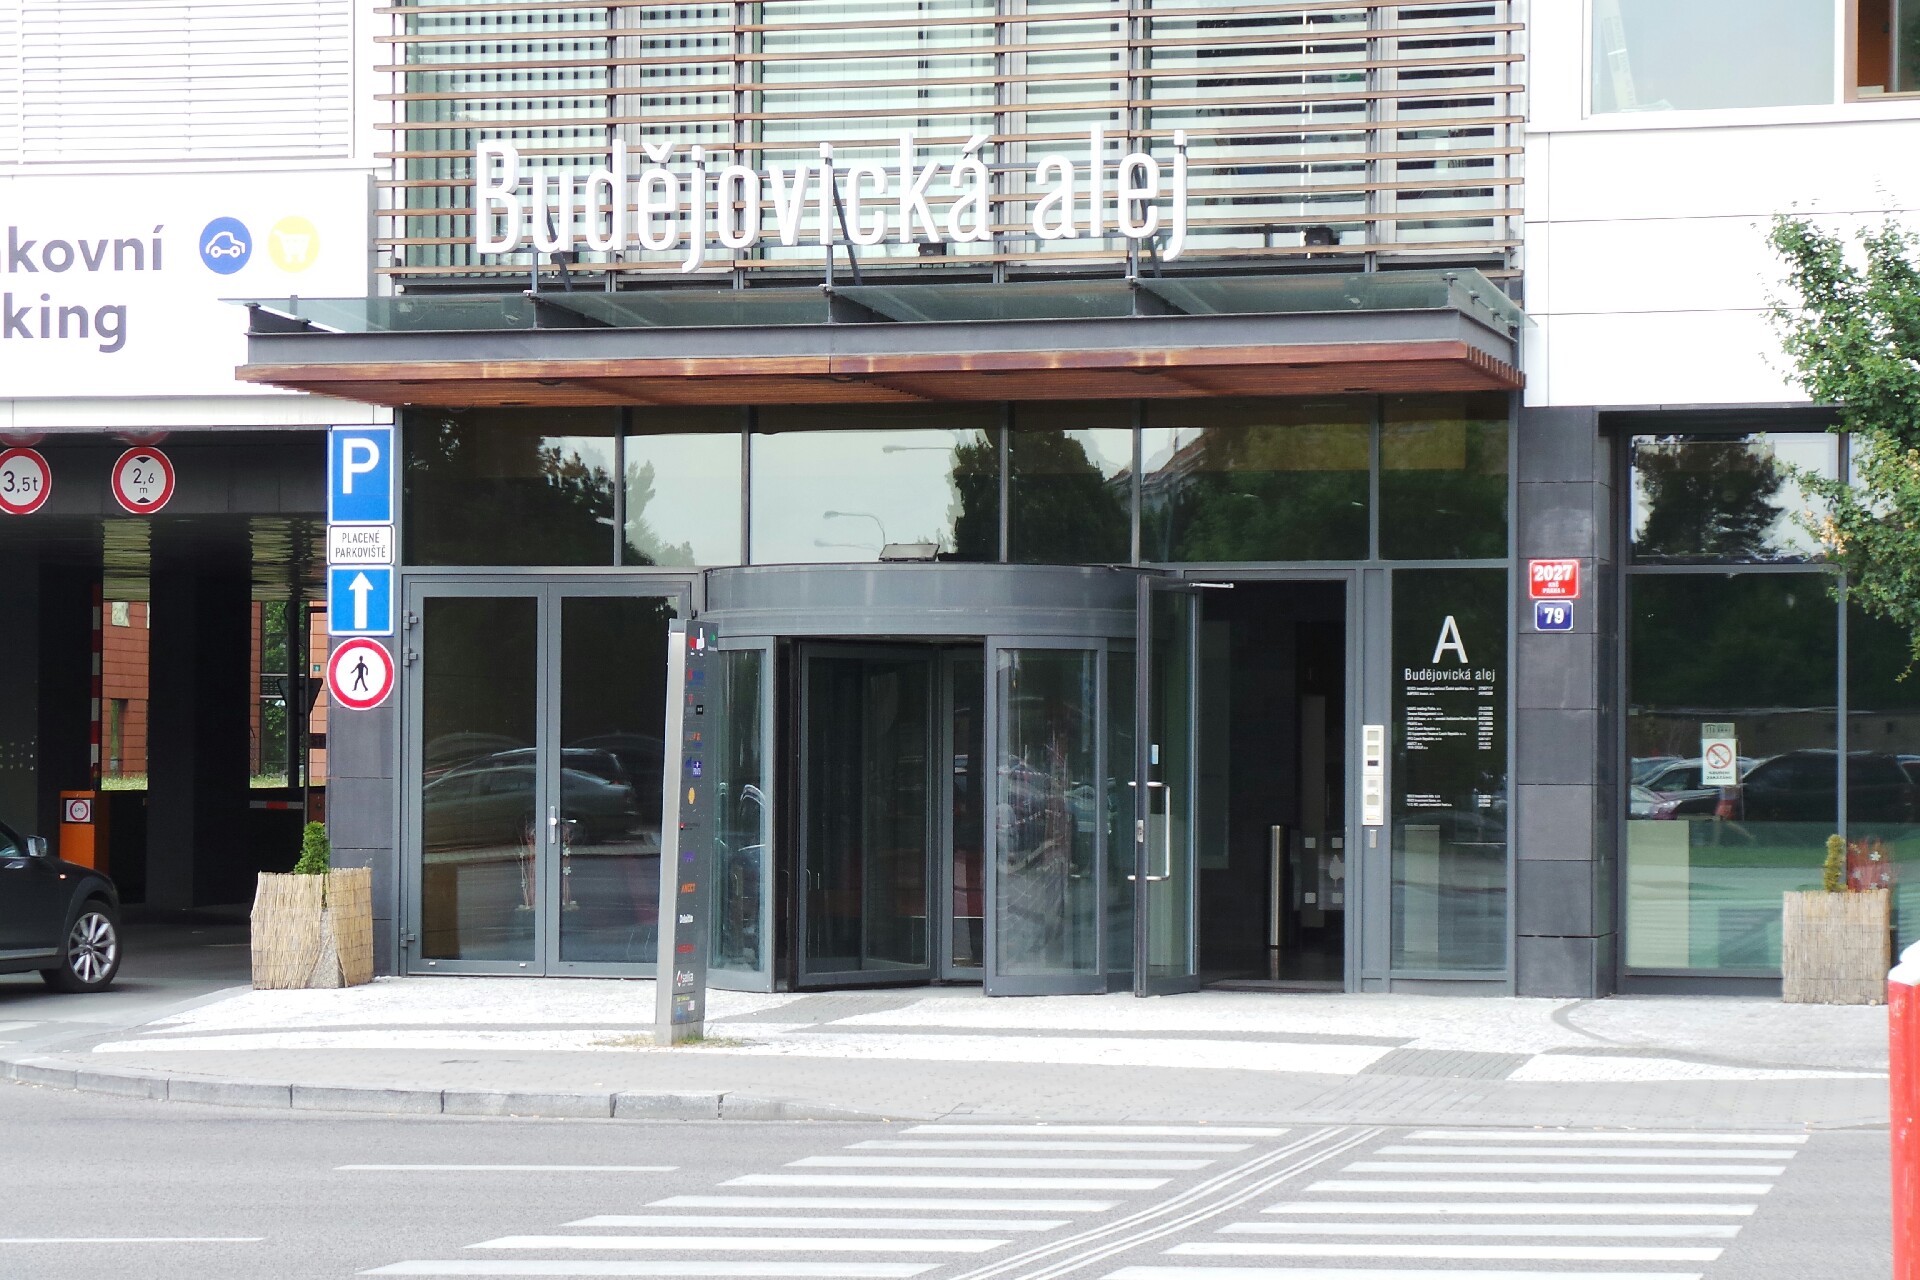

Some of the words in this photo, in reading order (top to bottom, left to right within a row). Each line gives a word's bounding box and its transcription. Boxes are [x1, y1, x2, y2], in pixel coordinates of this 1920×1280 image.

[477, 132, 991, 273] Budějovická
[1033, 123, 1188, 261] alej
[0, 224, 164, 273] kovní
[342, 437, 380, 495] P
[133, 468, 155, 485] 2,6
[342, 530, 380, 544] PLACENÉ
[335, 545, 386, 558] PARKOVIŠTĚ
[1533, 564, 1573, 582] 2027
[1544, 607, 1564, 624] 79
[1432, 615, 1469, 664] A
[1404, 667, 1471, 683] Budějovická
[1475, 667, 1496, 683] alej
